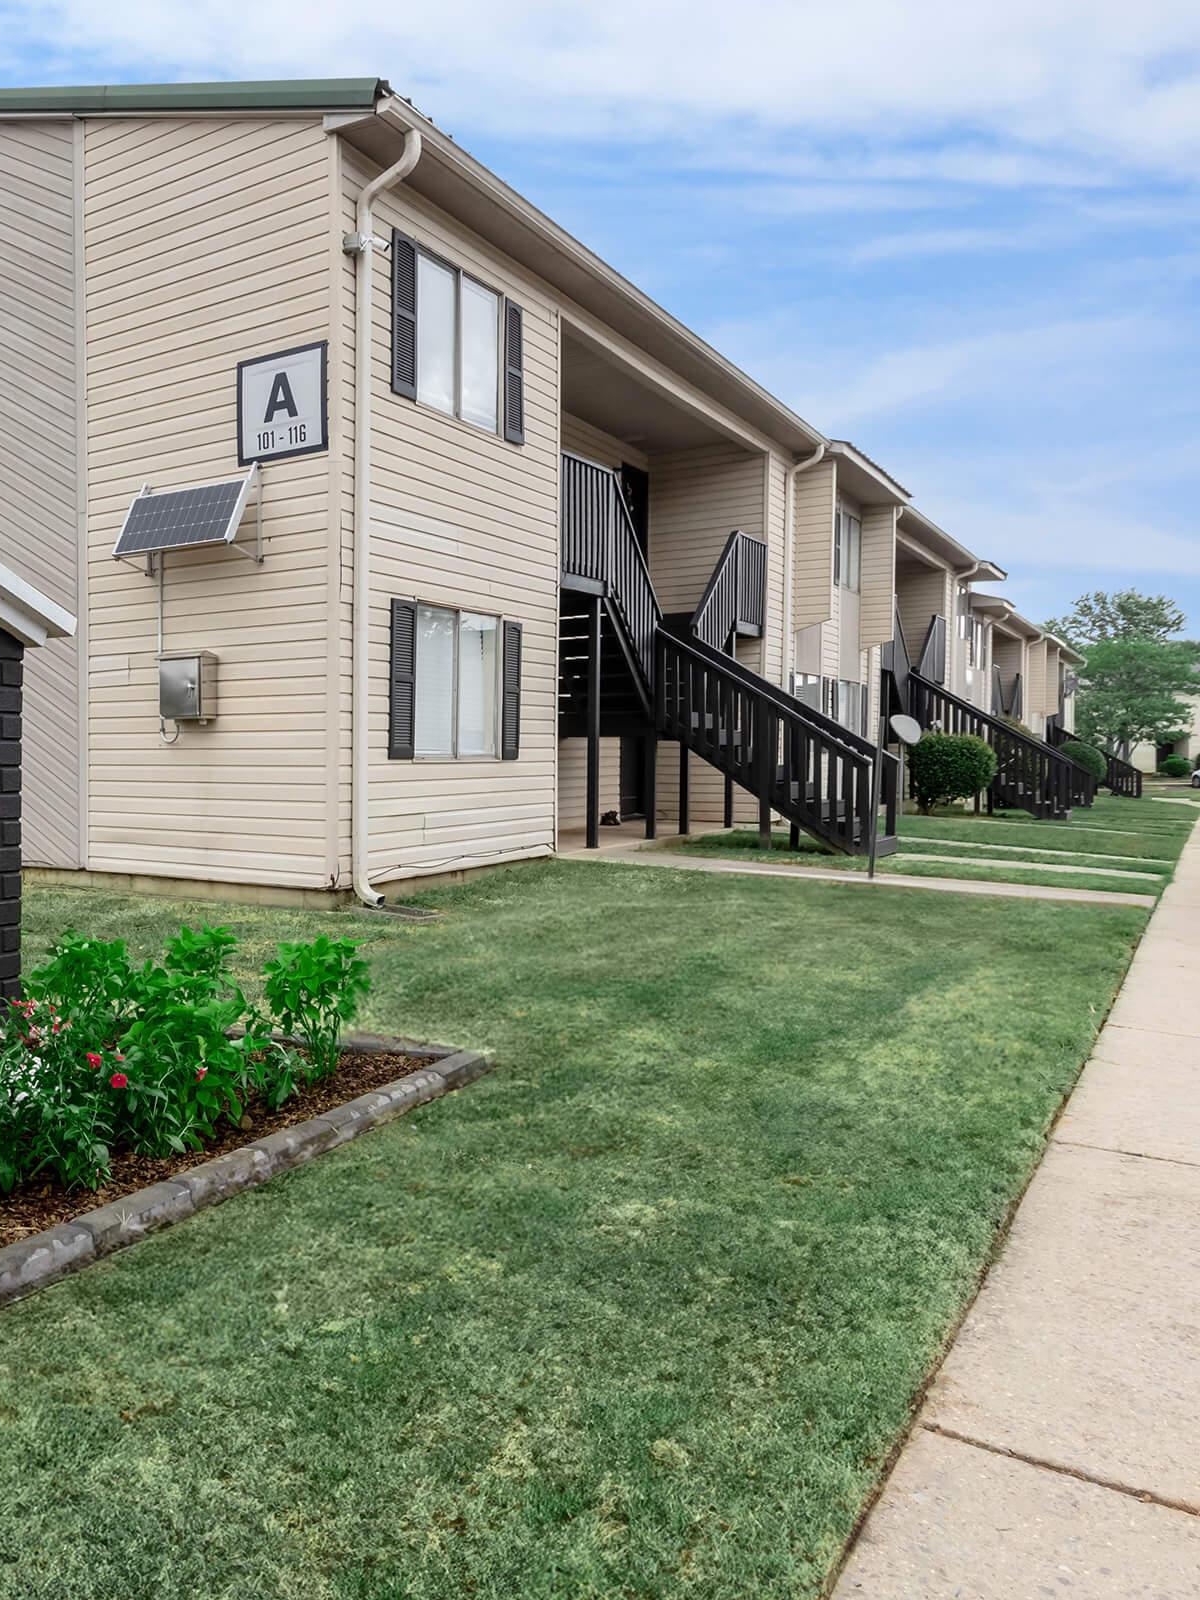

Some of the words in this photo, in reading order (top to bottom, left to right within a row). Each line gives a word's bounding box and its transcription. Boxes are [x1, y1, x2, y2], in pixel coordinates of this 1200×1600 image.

[264, 372, 298, 423] A
[257, 430, 275, 451] 101
[288, 424, 306, 445] 116
